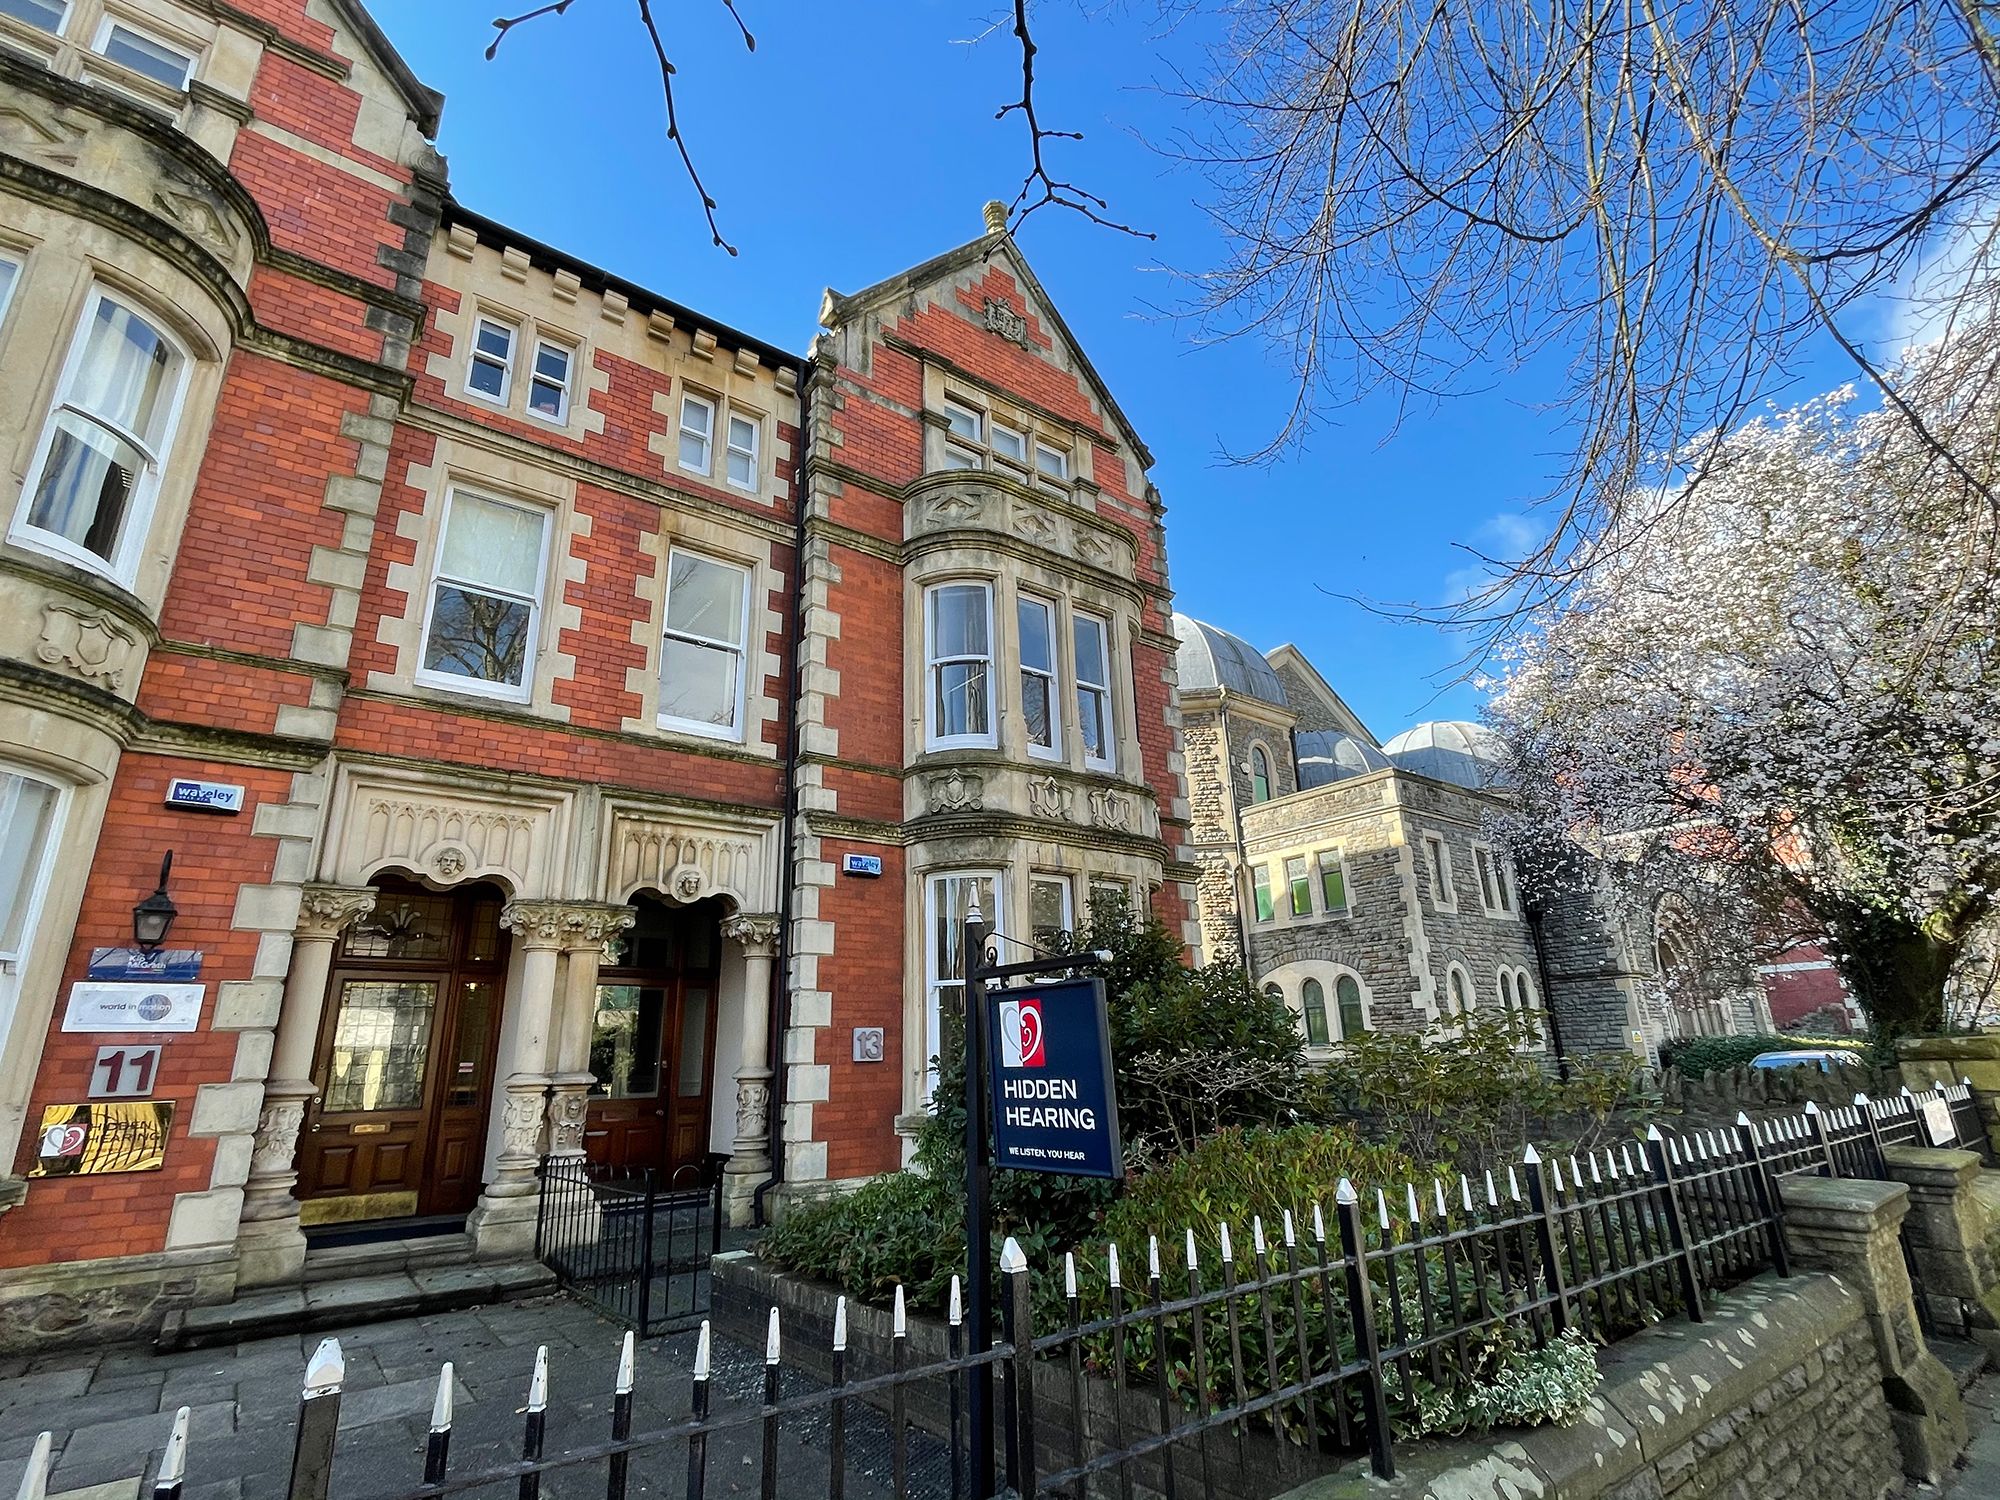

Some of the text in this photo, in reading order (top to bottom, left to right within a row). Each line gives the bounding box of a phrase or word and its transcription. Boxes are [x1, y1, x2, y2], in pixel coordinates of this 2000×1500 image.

[178, 787, 234, 803] waveley
[100, 1003, 126, 1011] world
[857, 1030, 883, 1059] 13
[99, 1050, 155, 1092] 11
[1004, 1079, 1077, 1100] HIDDEN
[1006, 1106, 1096, 1130] HEARING
[1009, 1146, 1019, 1155] WE
[1047, 1149, 1063, 1159] YOU
[1064, 1151, 1086, 1161] HEAR
